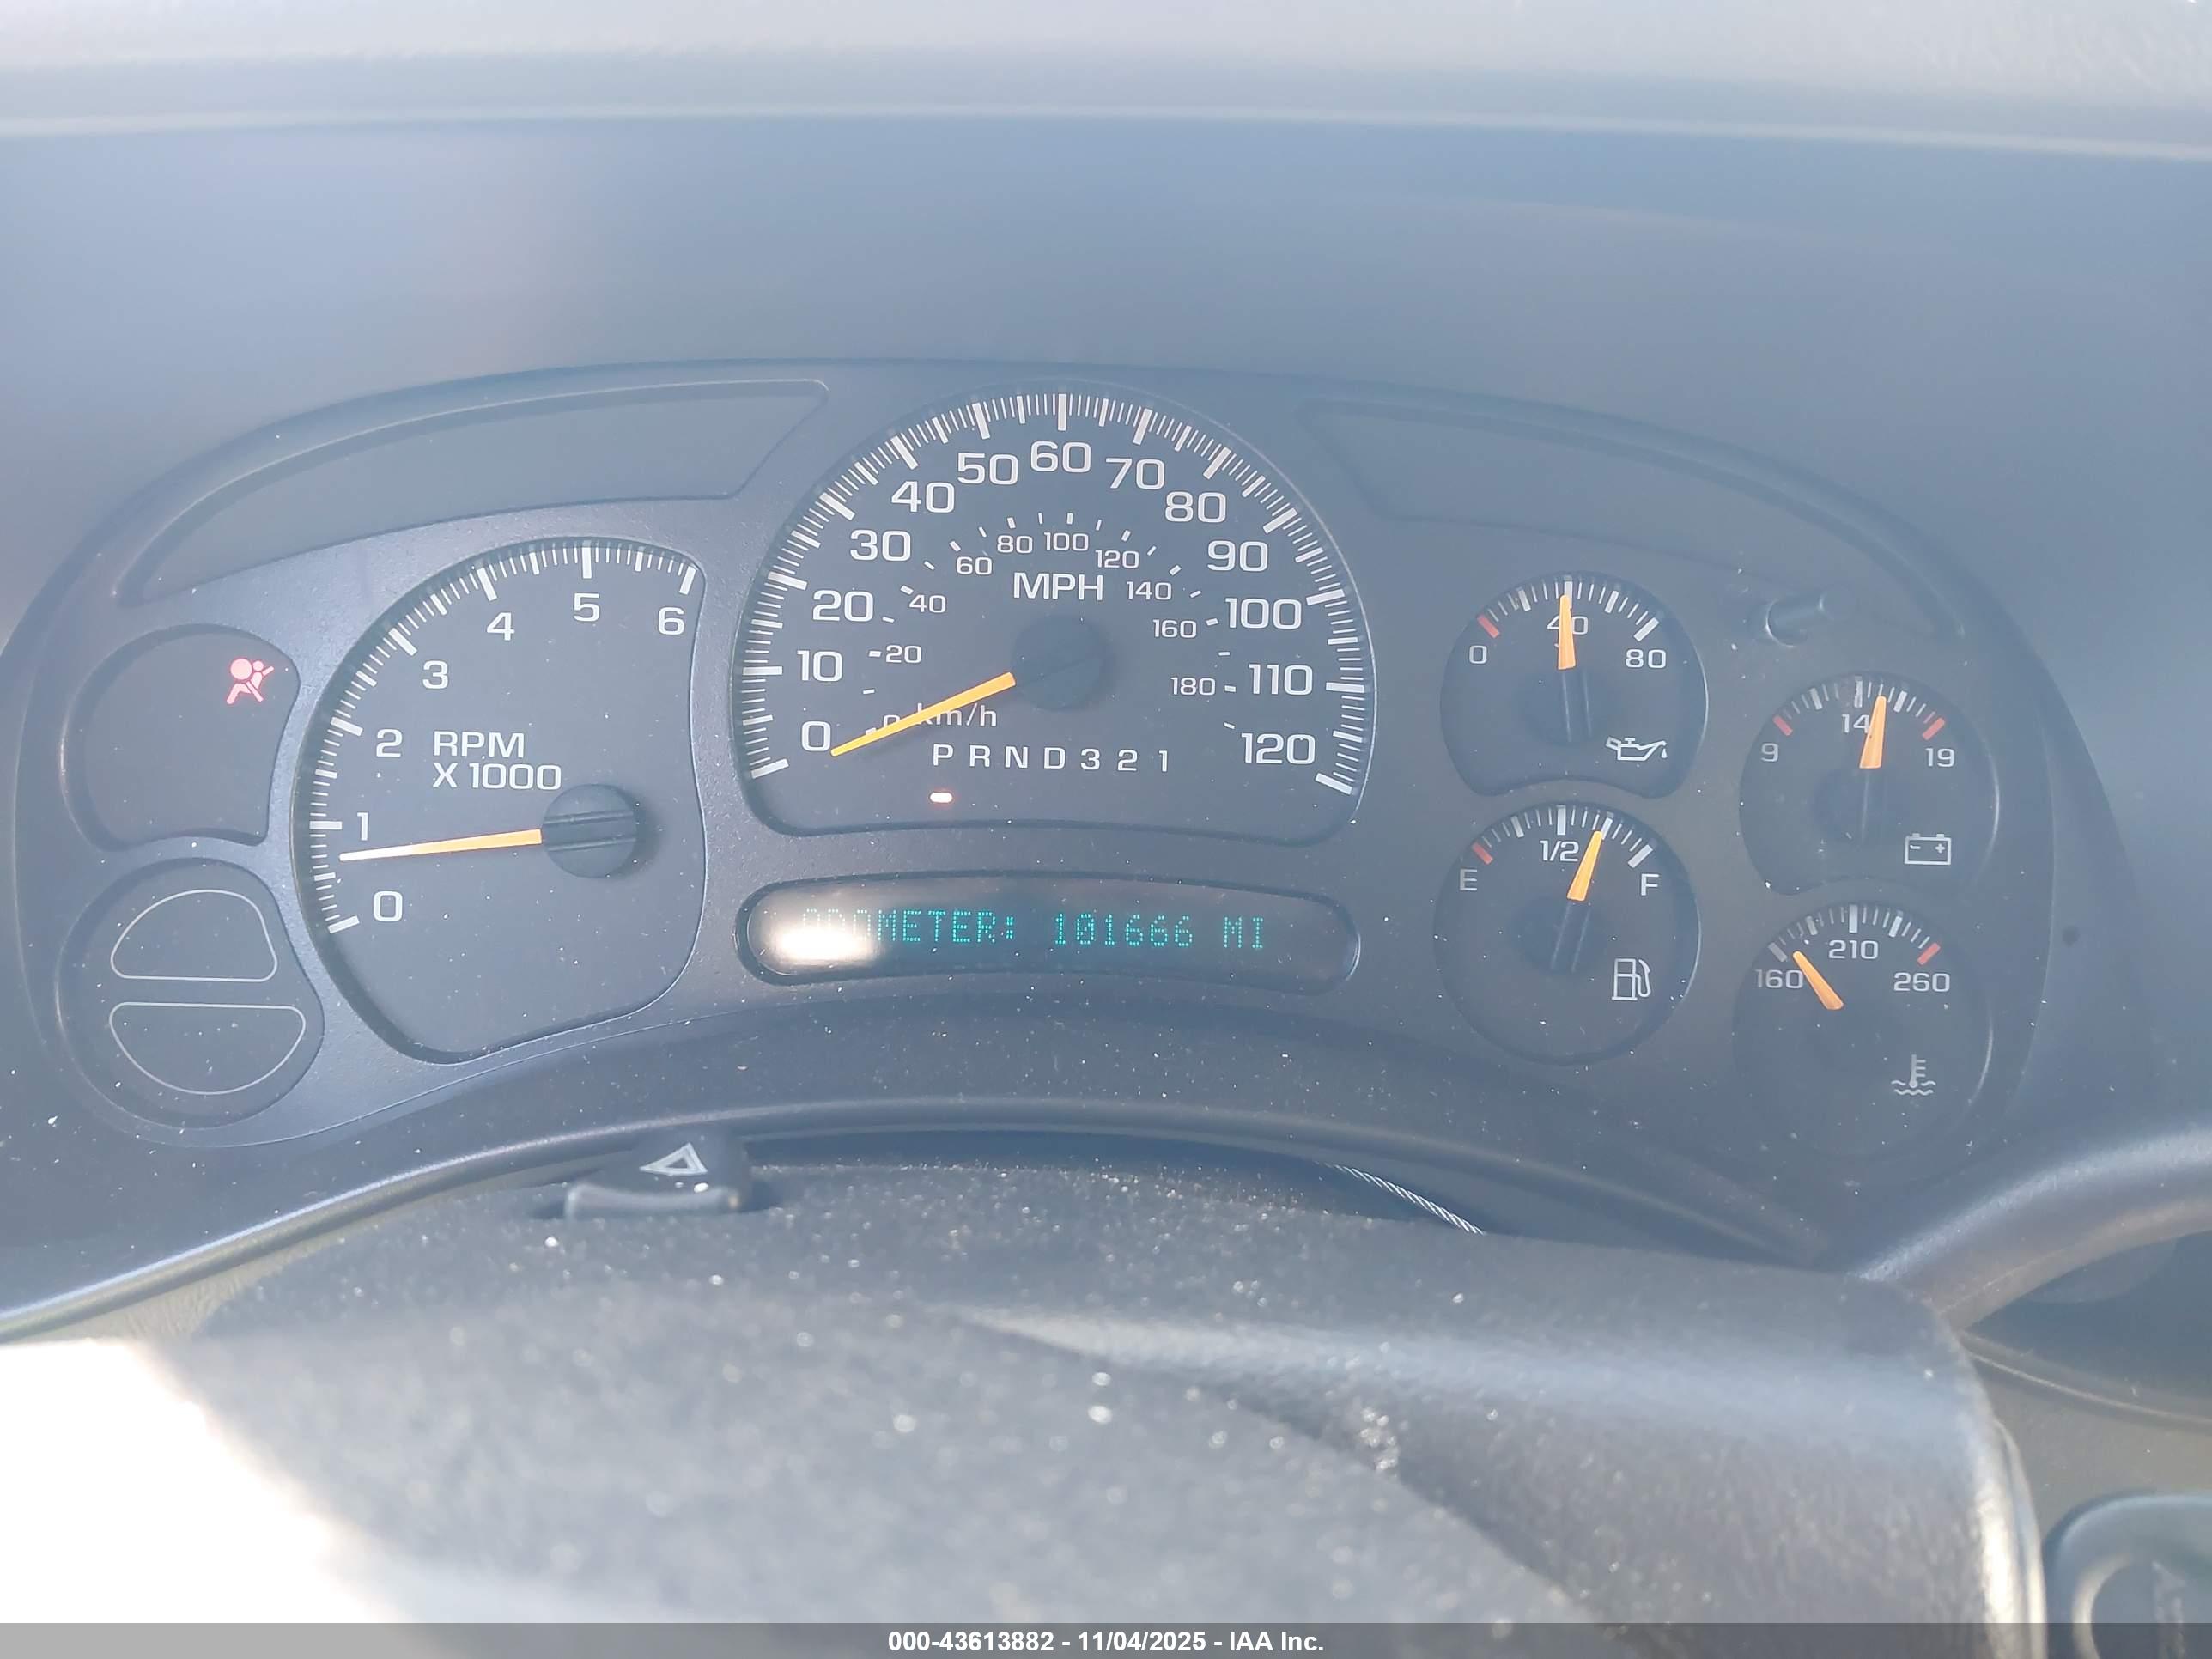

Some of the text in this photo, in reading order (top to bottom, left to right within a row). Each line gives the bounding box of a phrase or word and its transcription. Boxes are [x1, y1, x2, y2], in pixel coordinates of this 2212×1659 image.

[958, 453, 1018, 484] 50
[1031, 441, 1091, 472] 60
[1106, 459, 1164, 489] 70
[892, 482, 954, 513] 40
[1166, 492, 1225, 522] 80
[851, 530, 910, 561] 30
[998, 536, 1032, 553] 80
[1044, 532, 1088, 550] 100
[957, 557, 992, 574] 60
[1096, 550, 1139, 568] 120
[1208, 541, 1267, 571] 90
[1014, 573, 1103, 600] MPH
[1127, 582, 1171, 599] 140
[574, 593, 599, 621] 5
[813, 590, 872, 621] 20
[909, 595, 945, 612] 40
[1226, 599, 1301, 629] 100
[487, 613, 514, 640] 4
[659, 607, 684, 635] 6
[1153, 620, 1196, 637] 160
[798, 651, 842, 681] 10
[886, 645, 921, 663] 20
[1470, 646, 1486, 664] 0
[1626, 649, 1666, 668] 80
[423, 661, 447, 689] 3
[1171, 678, 1215, 695] 180
[1249, 665, 1312, 695] 110
[802, 721, 830, 750] 0
[1842, 714, 1870, 733] 14
[377, 729, 402, 757] 2
[434, 732, 524, 757] RPM
[1242, 733, 1315, 763] 120
[1762, 744, 1778, 762] 9
[1926, 748, 1954, 767] 19
[433, 763, 561, 789] X 1000
[357, 813, 368, 840] 1
[1540, 841, 1578, 861] 1/2
[1461, 870, 1477, 890] E
[1641, 874, 1659, 895] F
[374, 891, 402, 921] 0
[1055, 913, 1193, 946] 101666
[1224, 916, 1264, 948] MI
[1829, 940, 1878, 958] 210
[1757, 969, 1803, 989] 160
[1894, 973, 1949, 991] 260
